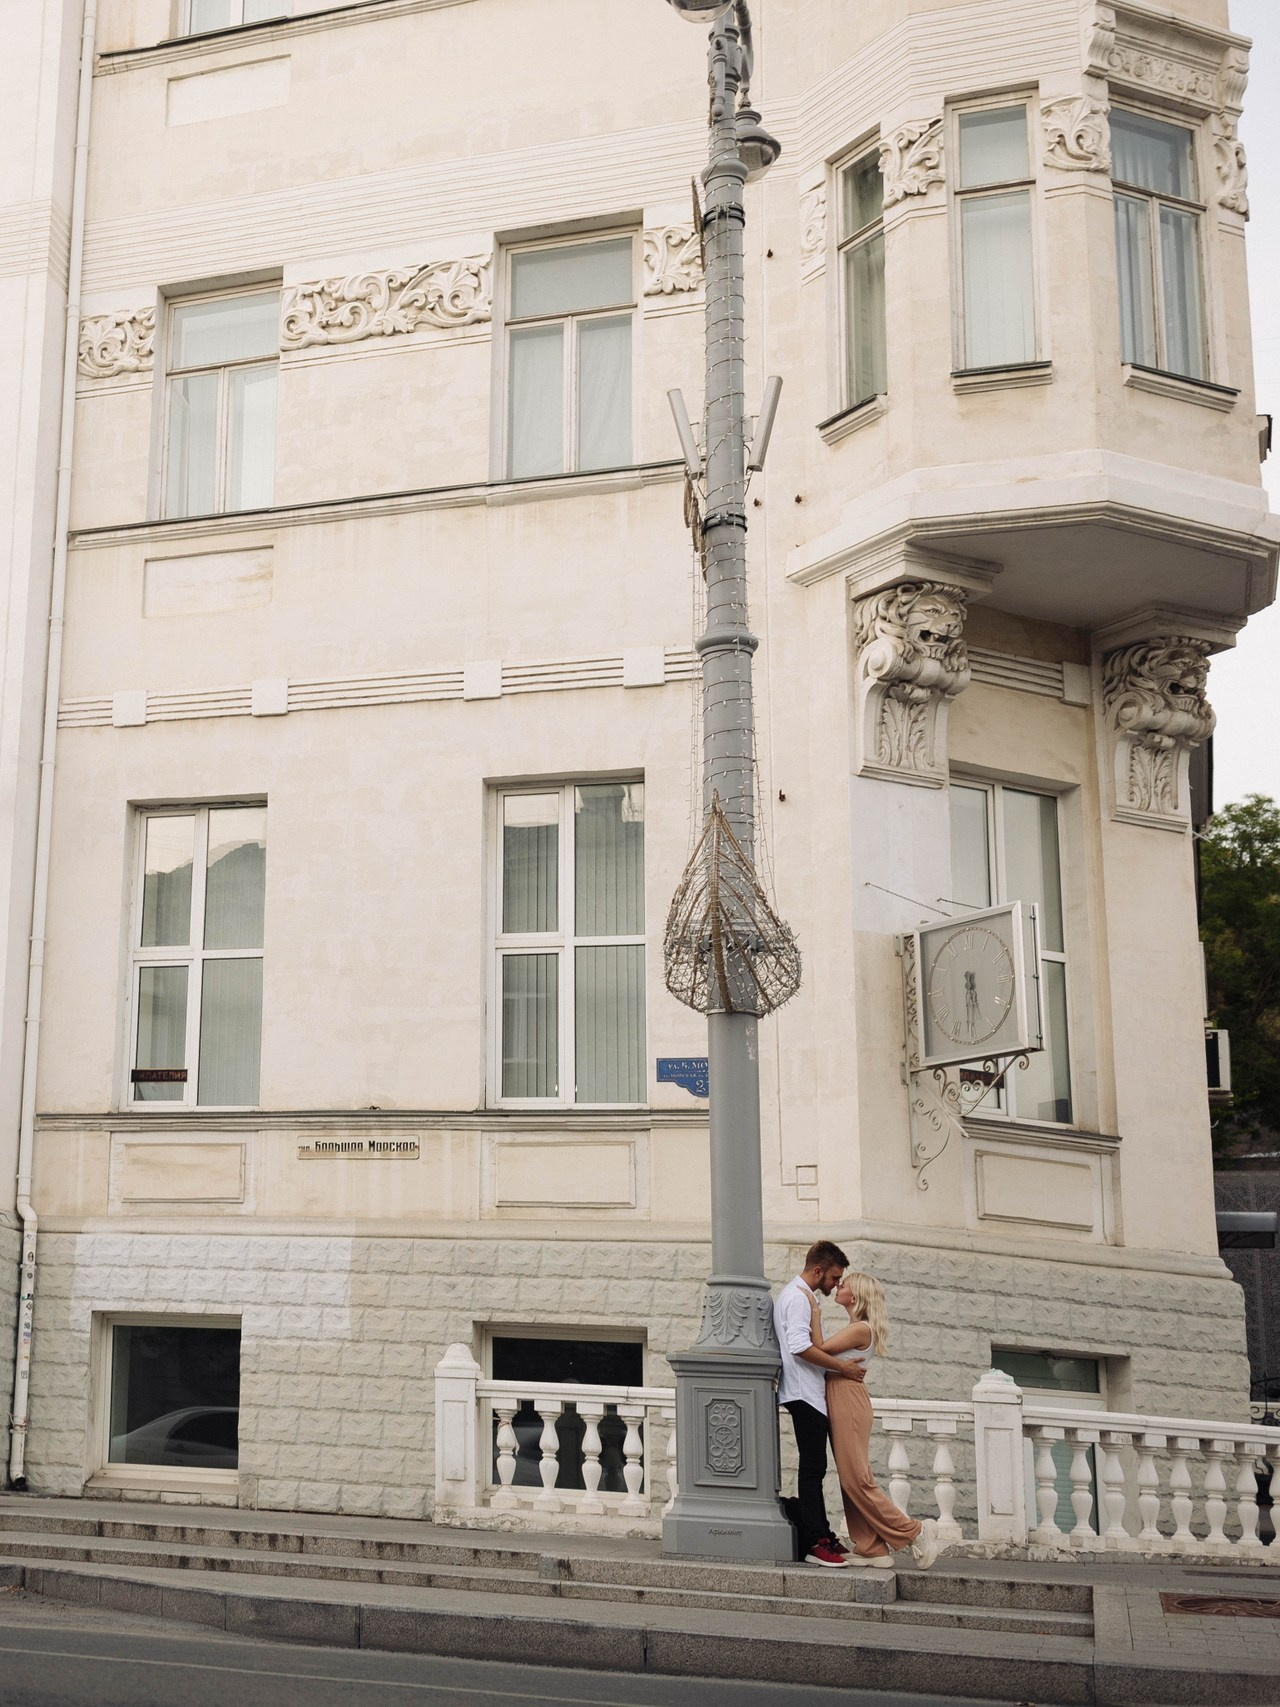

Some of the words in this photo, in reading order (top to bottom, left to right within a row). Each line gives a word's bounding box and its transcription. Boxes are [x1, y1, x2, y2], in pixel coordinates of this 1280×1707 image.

[135, 1071, 187, 1080] ИЛАТЕЛИЯ
[315, 1141, 363, 1152] Большая
[368, 1140, 415, 1152] Морская
